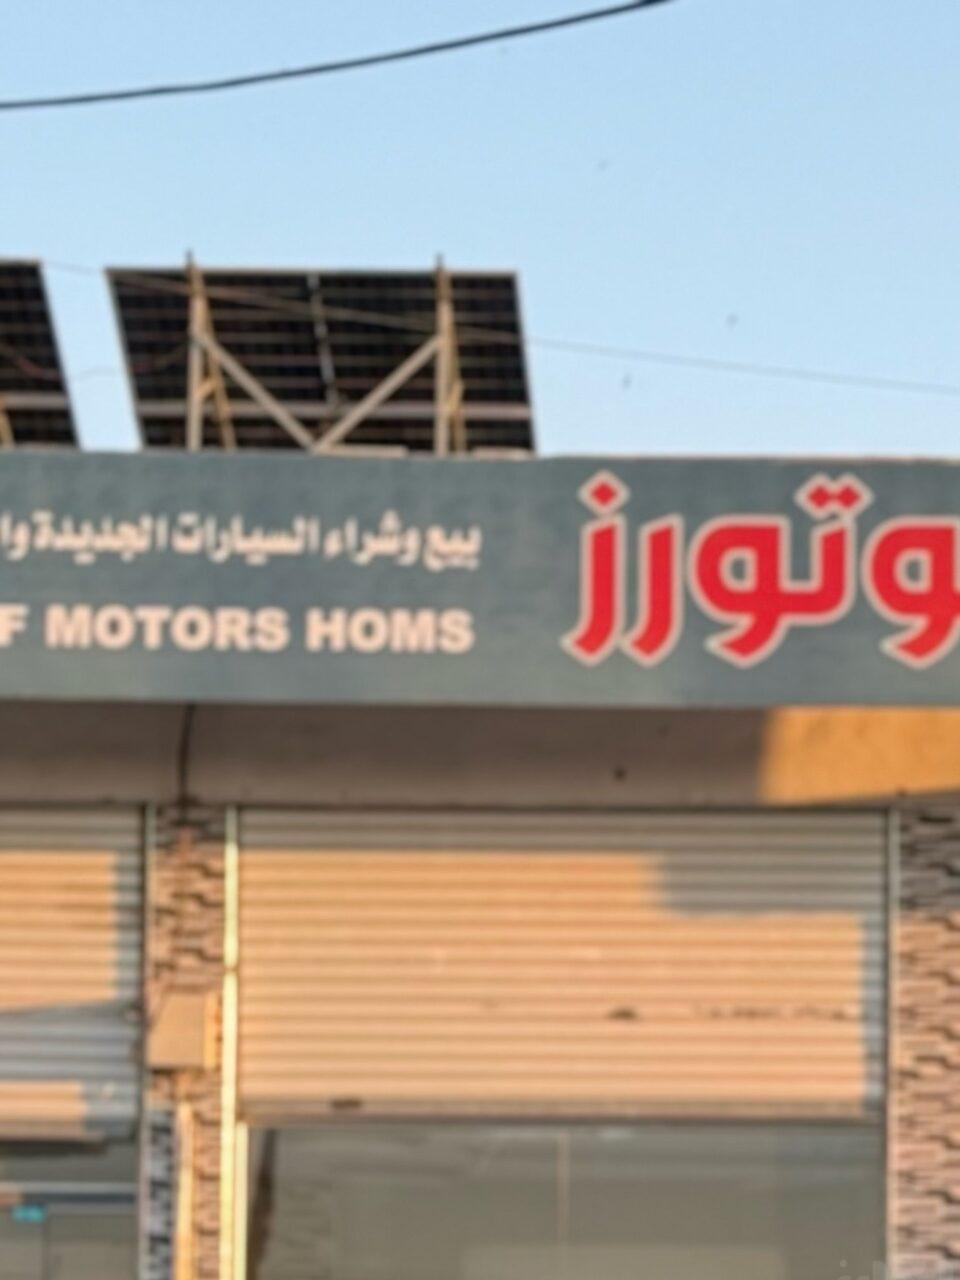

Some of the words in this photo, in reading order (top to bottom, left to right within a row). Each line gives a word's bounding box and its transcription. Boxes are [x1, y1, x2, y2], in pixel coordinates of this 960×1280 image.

[32, 510, 170, 566] الجديدة
[172, 510, 321, 567] السيارات
[324, 509, 421, 567] وشراء
[424, 523, 483, 572] بيع
[44, 603, 290, 652] MOTORS
[304, 605, 476, 655] HOMS
